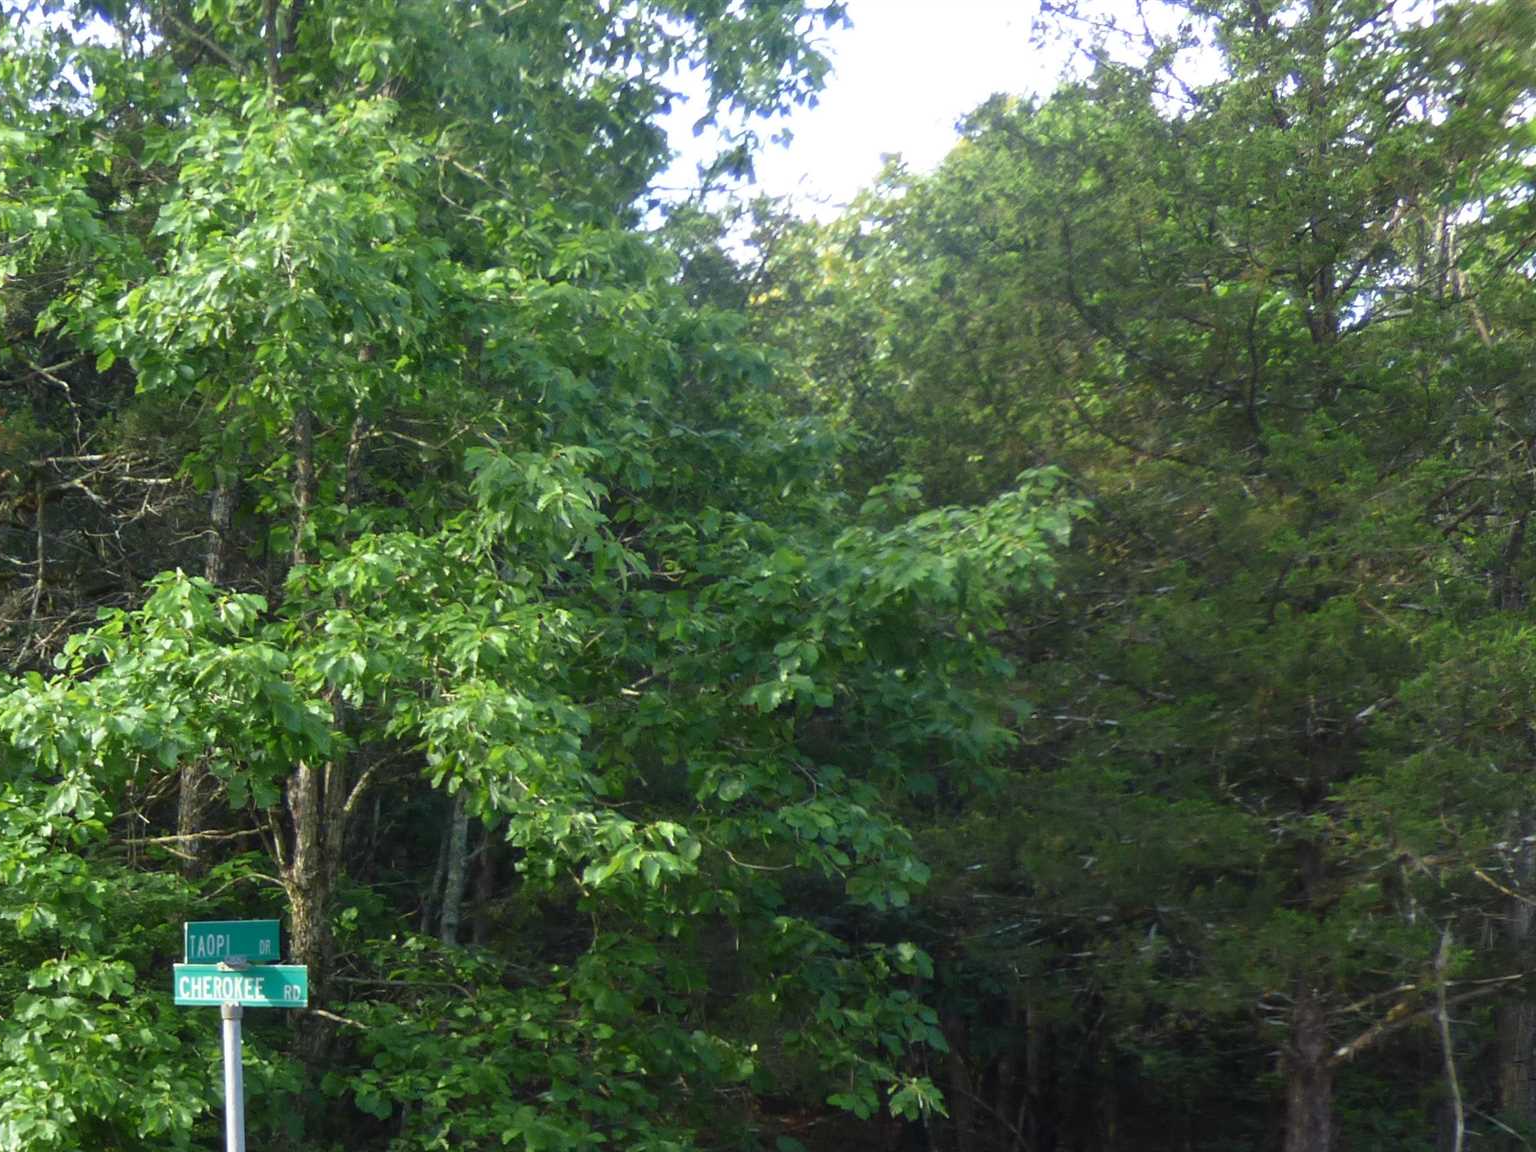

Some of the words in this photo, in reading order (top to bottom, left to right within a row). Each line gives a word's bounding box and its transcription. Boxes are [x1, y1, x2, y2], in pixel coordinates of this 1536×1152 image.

[190, 934, 230, 958] TAOPI
[259, 940, 271, 955] DR
[179, 976, 265, 999] CHEROKEE
[284, 985, 301, 1000] RD
